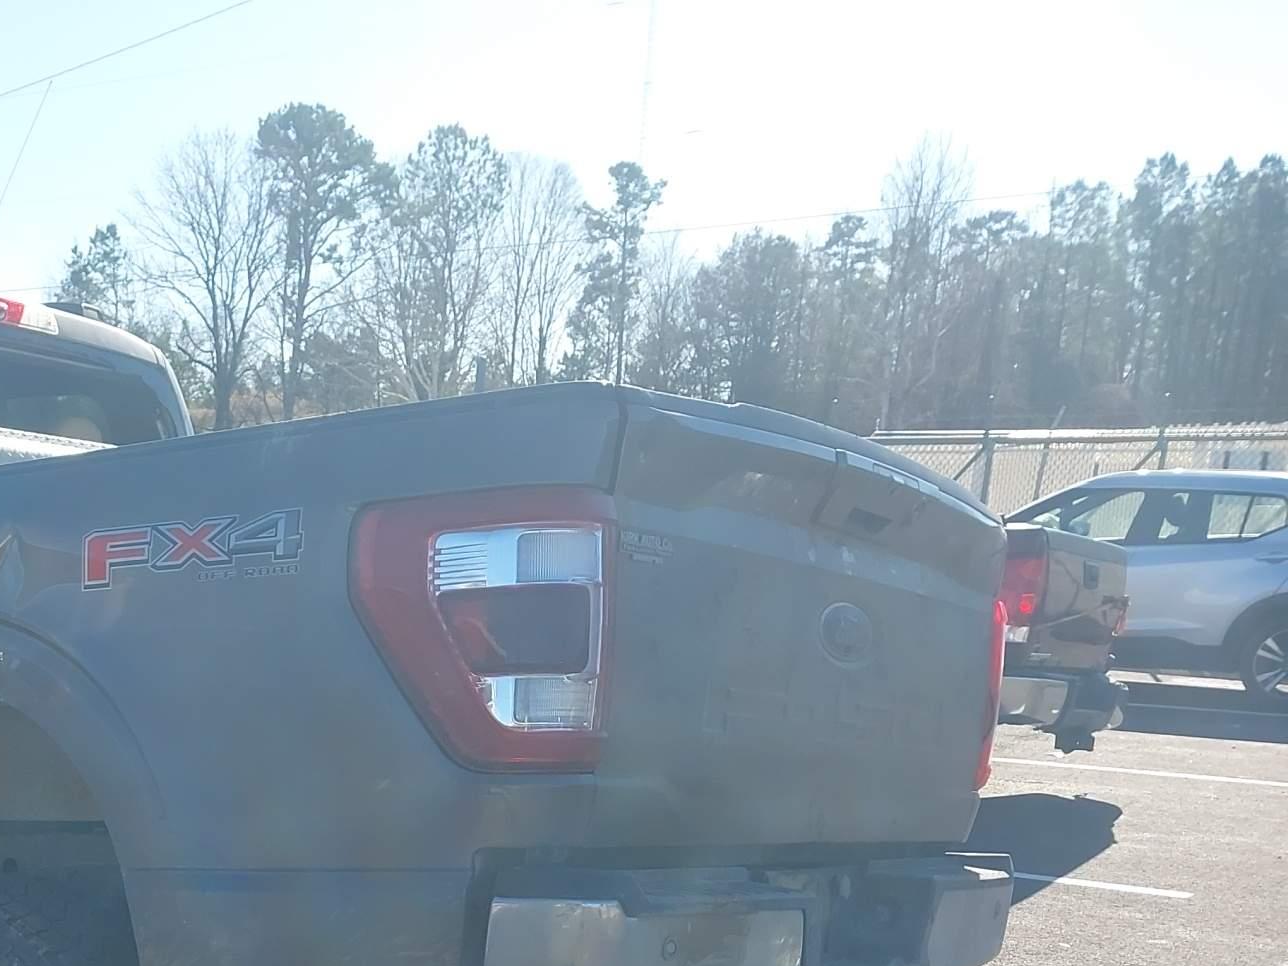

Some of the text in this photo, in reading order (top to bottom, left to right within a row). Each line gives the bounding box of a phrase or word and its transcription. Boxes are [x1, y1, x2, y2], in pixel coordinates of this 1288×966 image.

[81, 507, 305, 592] FX4
[197, 563, 300, 583] OFF ROAD
